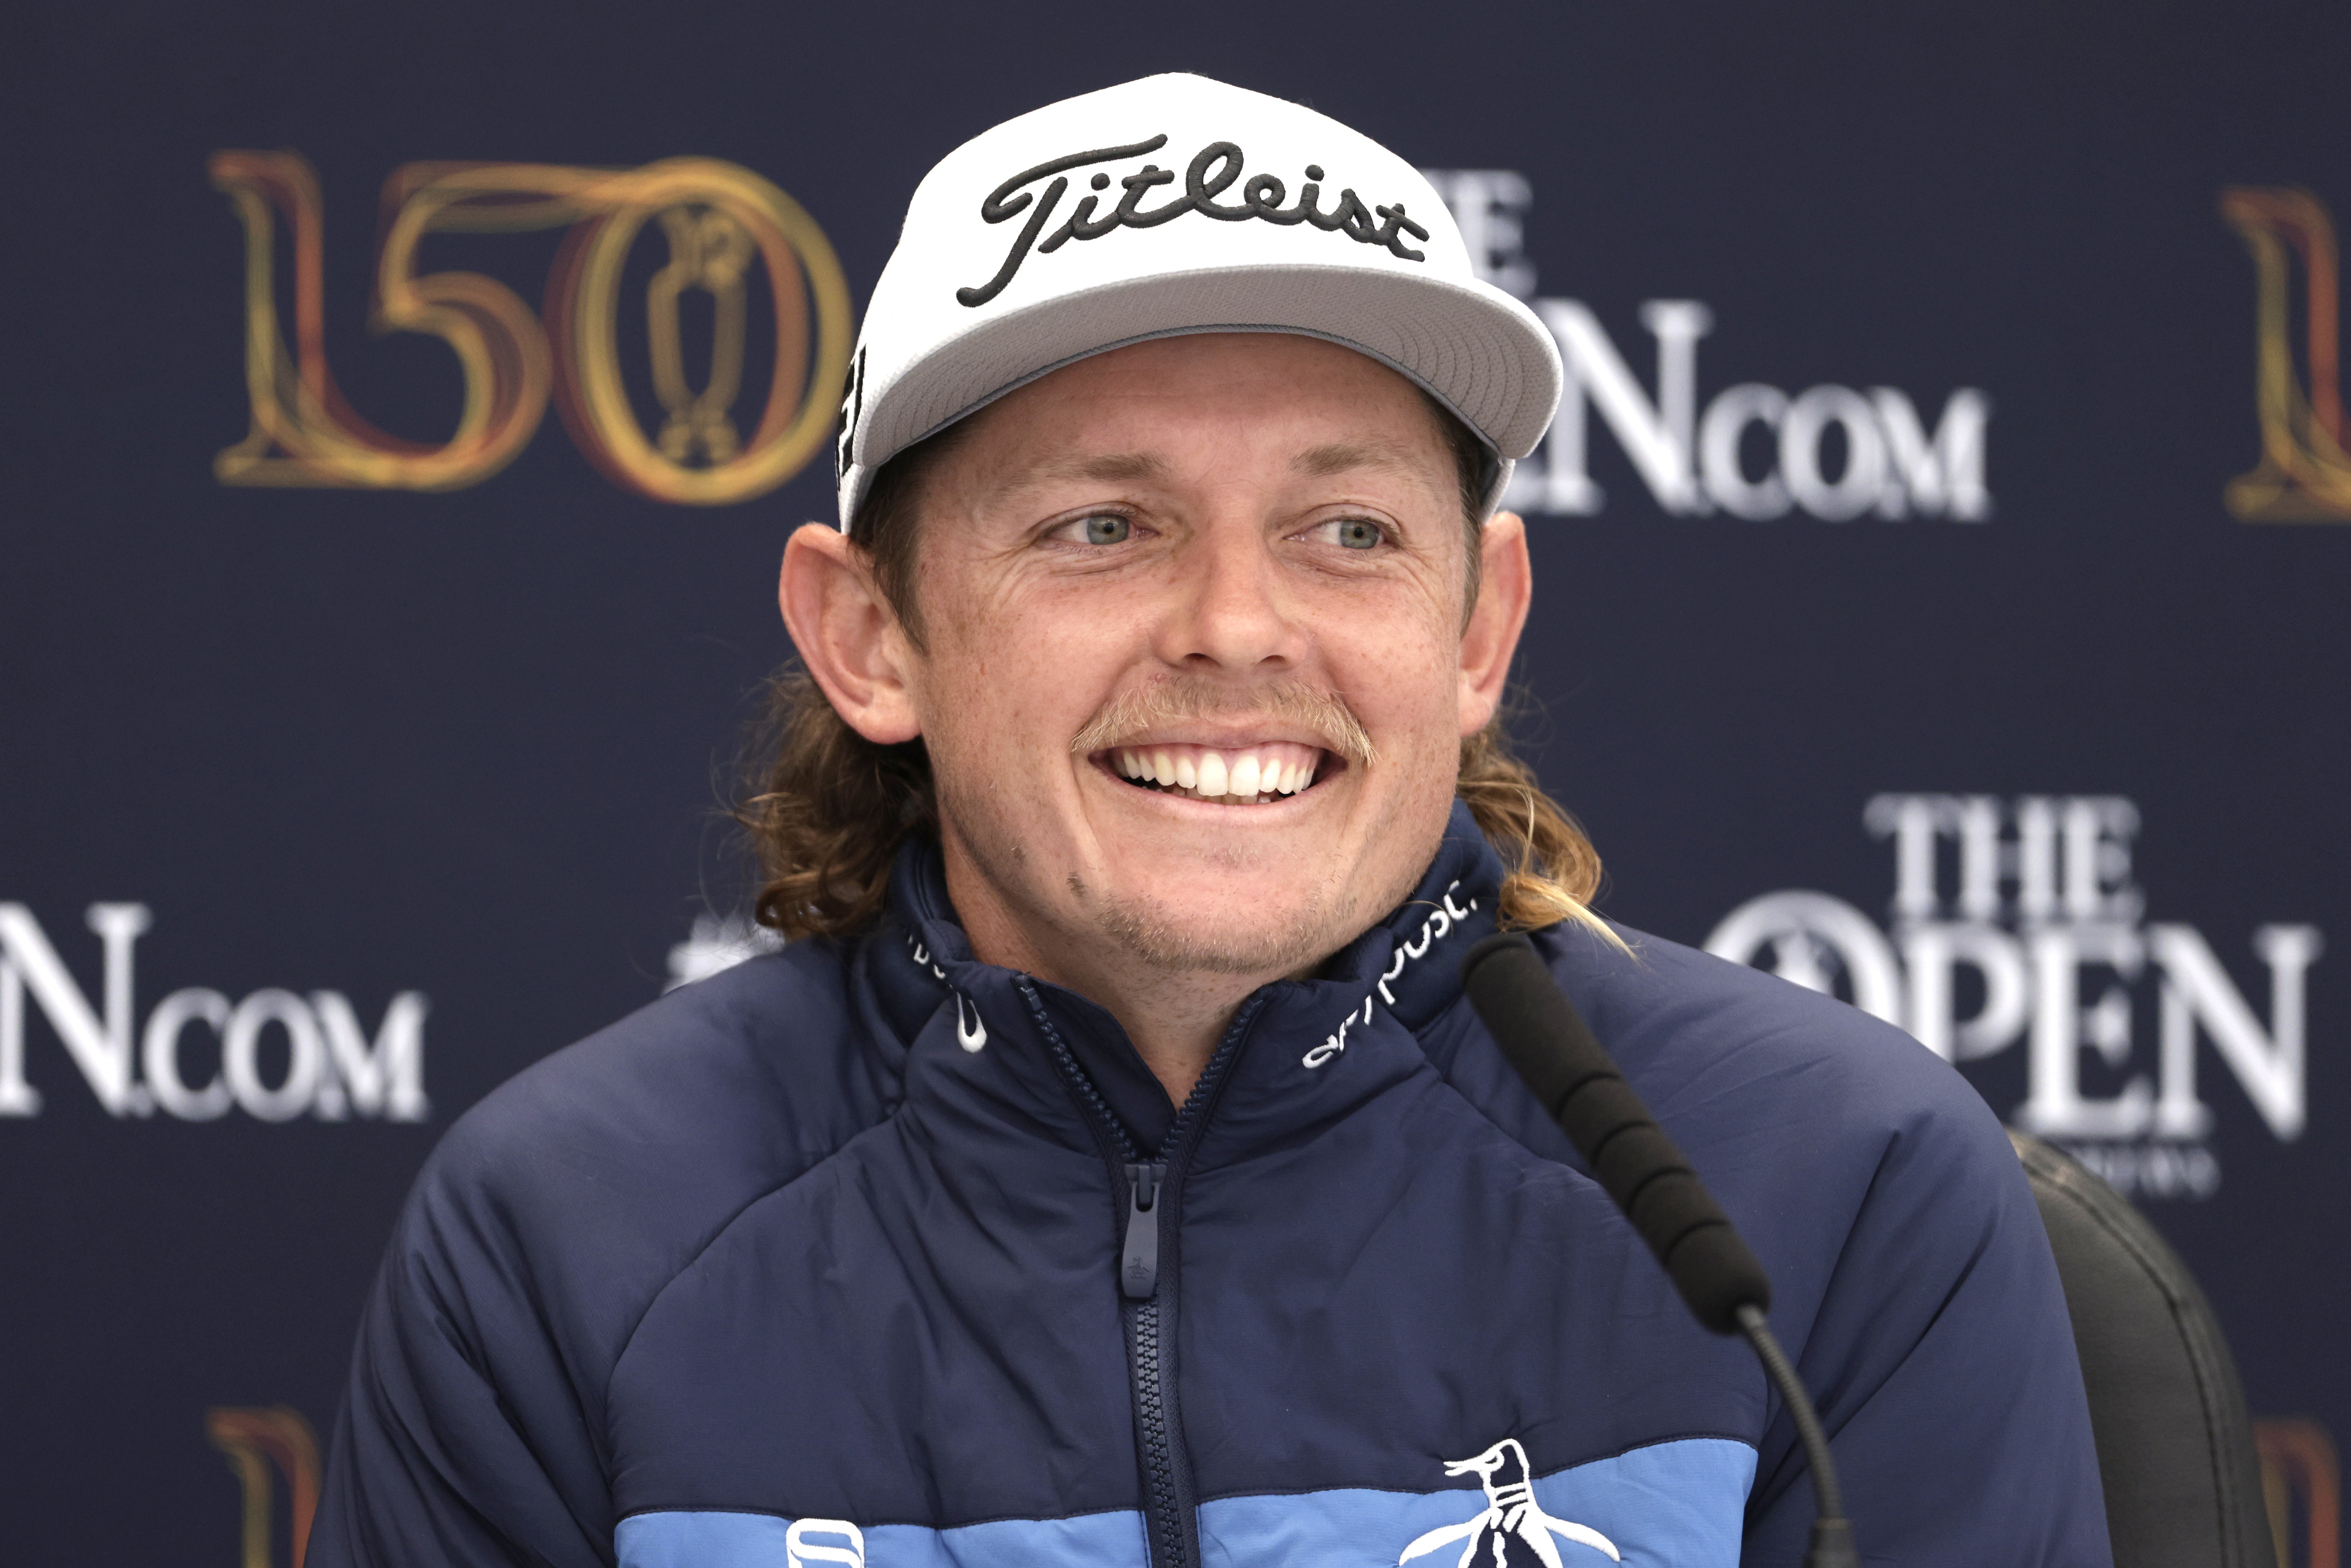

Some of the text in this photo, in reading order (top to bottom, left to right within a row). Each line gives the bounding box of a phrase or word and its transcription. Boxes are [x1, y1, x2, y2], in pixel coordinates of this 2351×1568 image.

[956, 133, 1430, 308] Titleist
[207, 149, 856, 506] 150
[1503, 298, 1993, 521] N.COM
[1865, 794, 2144, 922] THE
